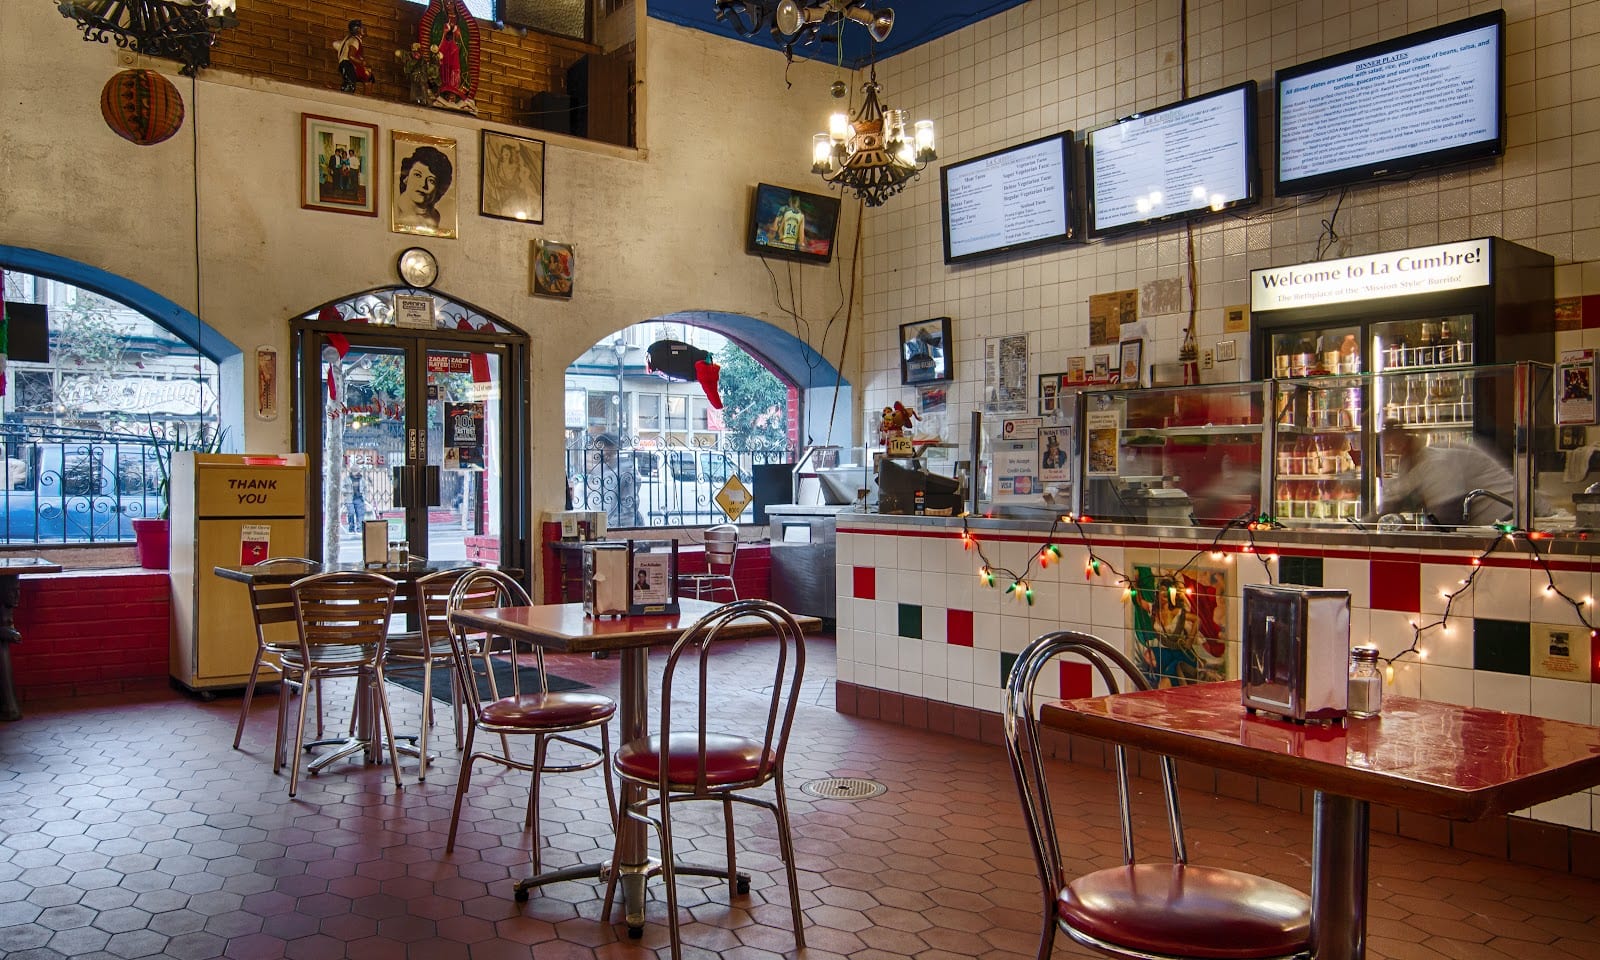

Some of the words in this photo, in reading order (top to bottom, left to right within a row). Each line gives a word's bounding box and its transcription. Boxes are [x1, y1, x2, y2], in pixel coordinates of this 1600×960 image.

[1311, 80, 1326, 89] plates
[1337, 73, 1353, 82] served
[1355, 70, 1366, 78] with
[1398, 59, 1410, 67] your
[1413, 54, 1431, 64] choice
[1440, 47, 1457, 57] beans,
[1460, 42, 1476, 52] salsa,
[1478, 39, 1490, 47] and
[1356, 59, 1380, 70] DINNER
[1383, 52, 1408, 63] PLATES
[1262, 268, 1341, 289] Welcome
[1346, 264, 1364, 279] to
[1371, 260, 1389, 276] La
[1397, 247, 1481, 272] Cumbre!
[1278, 294, 1291, 302] The
[1294, 290, 1333, 301] Birthplace
[1346, 286, 1359, 294] the
[1428, 275, 1462, 286] Burrito!
[891, 439, 911, 451] TIPS
[228, 479, 277, 490] THANK
[238, 494, 267, 504] YOU
